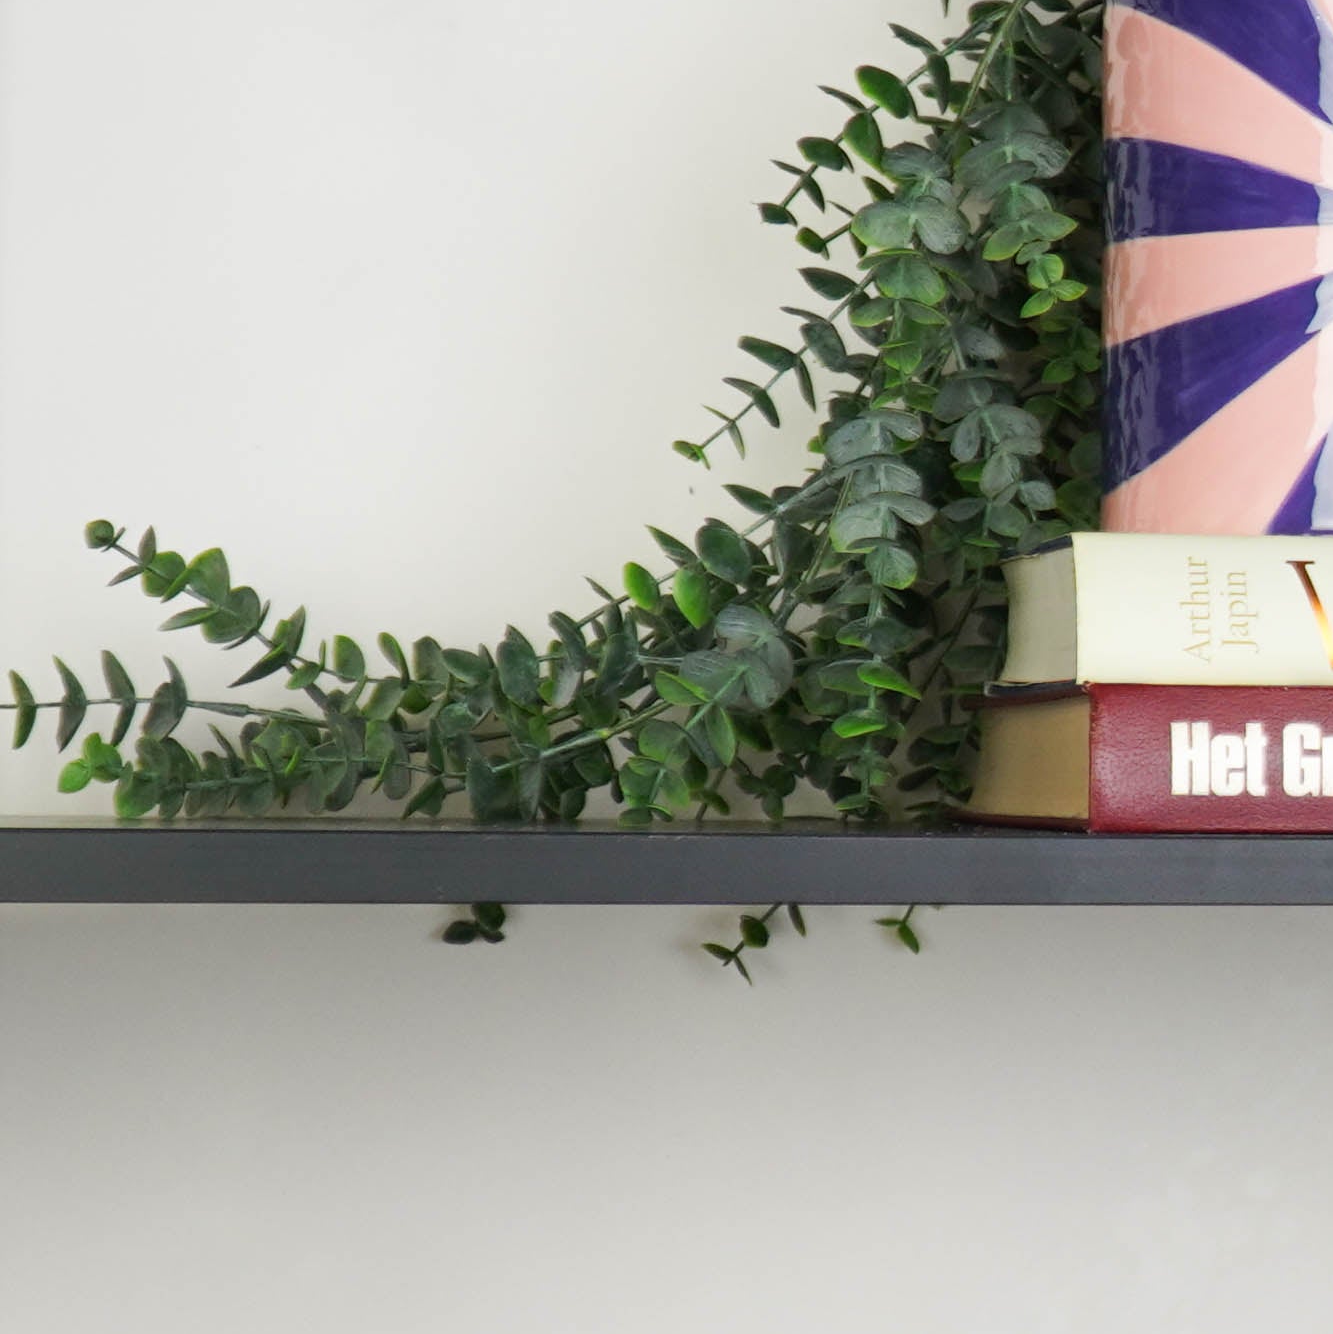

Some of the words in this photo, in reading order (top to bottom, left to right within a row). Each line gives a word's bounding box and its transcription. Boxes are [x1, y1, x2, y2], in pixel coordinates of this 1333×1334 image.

[1179, 555, 1211, 664] Arthur
[1220, 570, 1259, 654] Japin
[1170, 722, 1268, 797] Het
